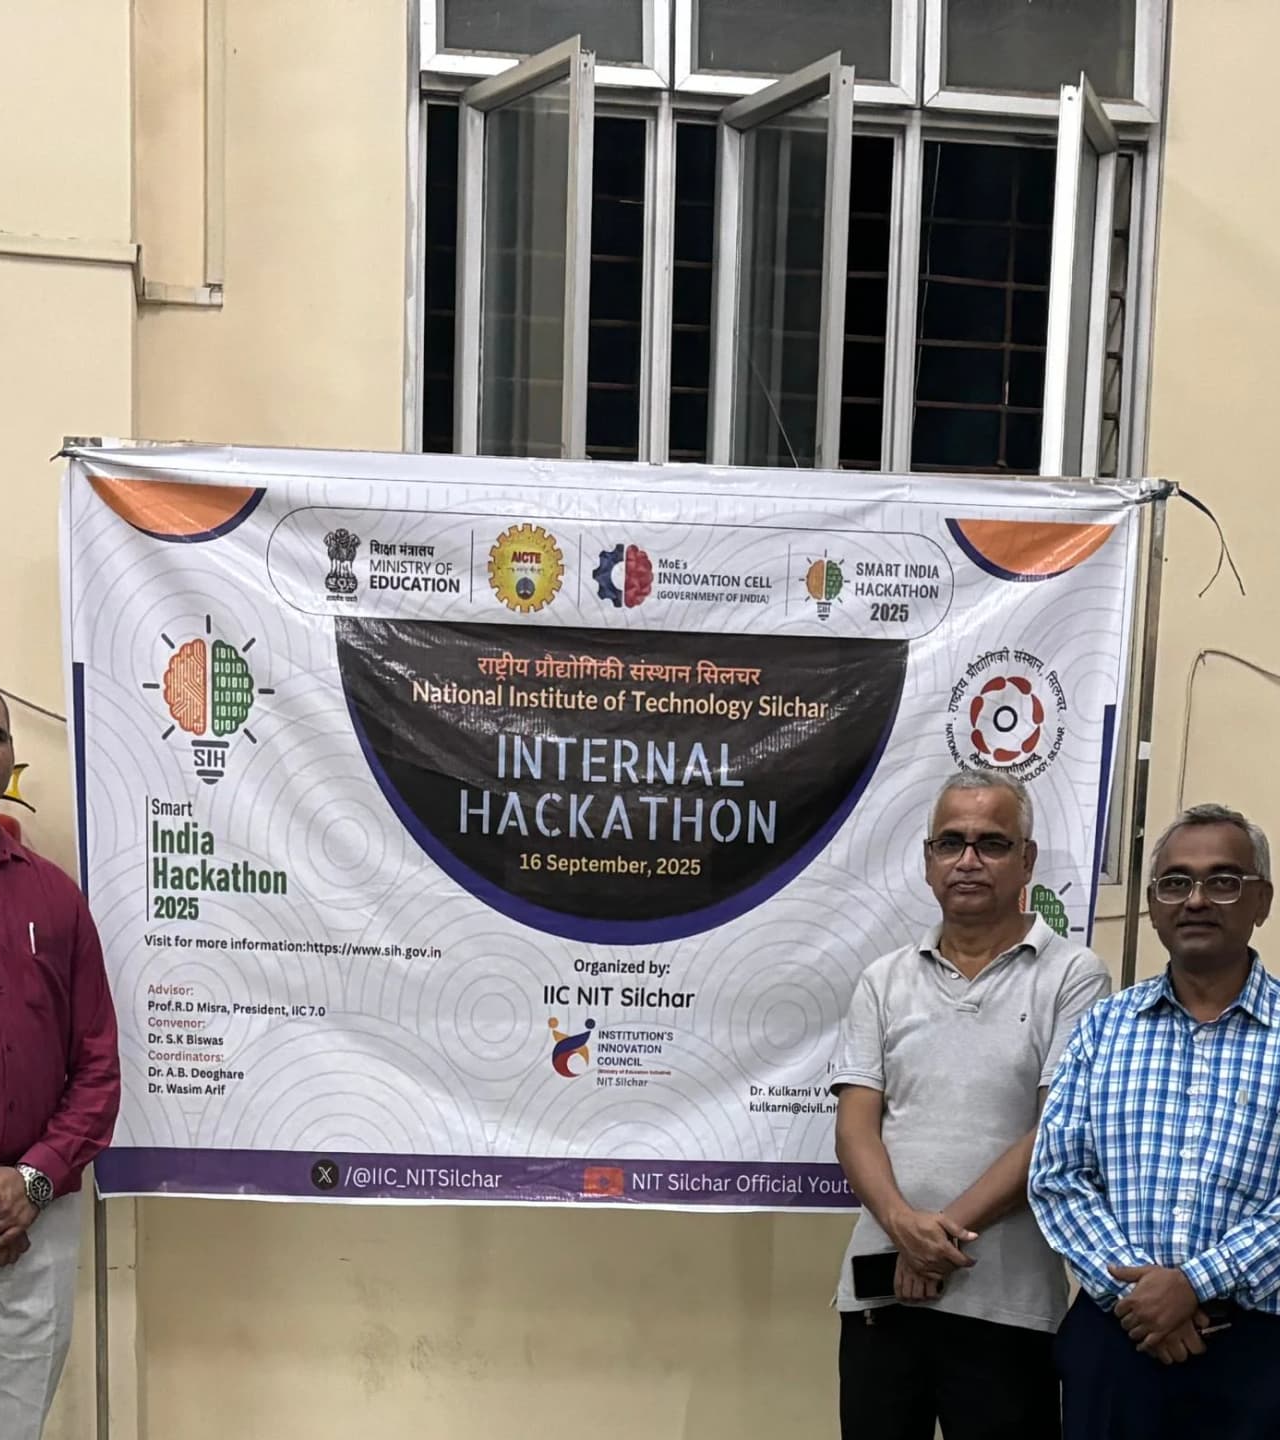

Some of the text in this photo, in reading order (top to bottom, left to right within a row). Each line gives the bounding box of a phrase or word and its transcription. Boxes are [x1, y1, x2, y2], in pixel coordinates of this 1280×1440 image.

[511, 551, 542, 564] AICTE
[369, 559, 454, 576] MINISTRY OF
[856, 562, 940, 579] SMART INDIA
[369, 575, 461, 594] EDUCATION
[658, 572, 773, 589] INNOVATION CELL
[657, 590, 770, 605] (GOVERNMENT OF INDIA)
[855, 582, 940, 599] HACKATHON
[870, 602, 910, 623] 2025
[477, 651, 761, 686] राष्ट्रीय प्रौद्योगिकी संस्थान सिलचर
[412, 681, 829, 720] National Institute of Technology Silchar
[193, 748, 226, 769] SIH
[496, 734, 745, 788] INTERNAL
[151, 798, 193, 817] Smart
[458, 789, 777, 845] HACKATHON
[152, 820, 215, 856] India
[519, 853, 702, 878] 16 September, 2025
[153, 857, 288, 895] Hackathon
[154, 896, 200, 921] 2025
[144, 934, 173, 948] Visit
[174, 935, 193, 949] for
[195, 938, 229, 950] more
[573, 958, 671, 978] Organized by:
[147, 984, 195, 997] Advisor:
[543, 985, 696, 1009] IIC NIT Silchar
[147, 1000, 326, 1018] Prof.R.D Misra, President, IIC 7.0
[147, 1016, 207, 1030] Convenor:
[147, 1033, 225, 1046] Dr. S.K Biswas
[598, 1029, 675, 1042] INSTITUTION'S
[147, 1050, 225, 1063] Coordinators:
[597, 1043, 663, 1054] INNOVATION
[596, 1056, 643, 1067] COUNCIL
[147, 1066, 245, 1082] Dr. A.B. Deoghare
[596, 1077, 649, 1088] NIT Silchar
[147, 1083, 227, 1096] Dr. Wasim Arif
[749, 1085, 766, 1097] Dr.
[768, 1085, 812, 1097] Kulkarni
[813, 1087, 822, 1097] V
[749, 1101, 837, 1115] kulkarni@civil.ni
[343, 1166, 503, 1188] /@IIC_NITSilchar
[631, 1173, 854, 1194] NIT Silchar Official Yout
